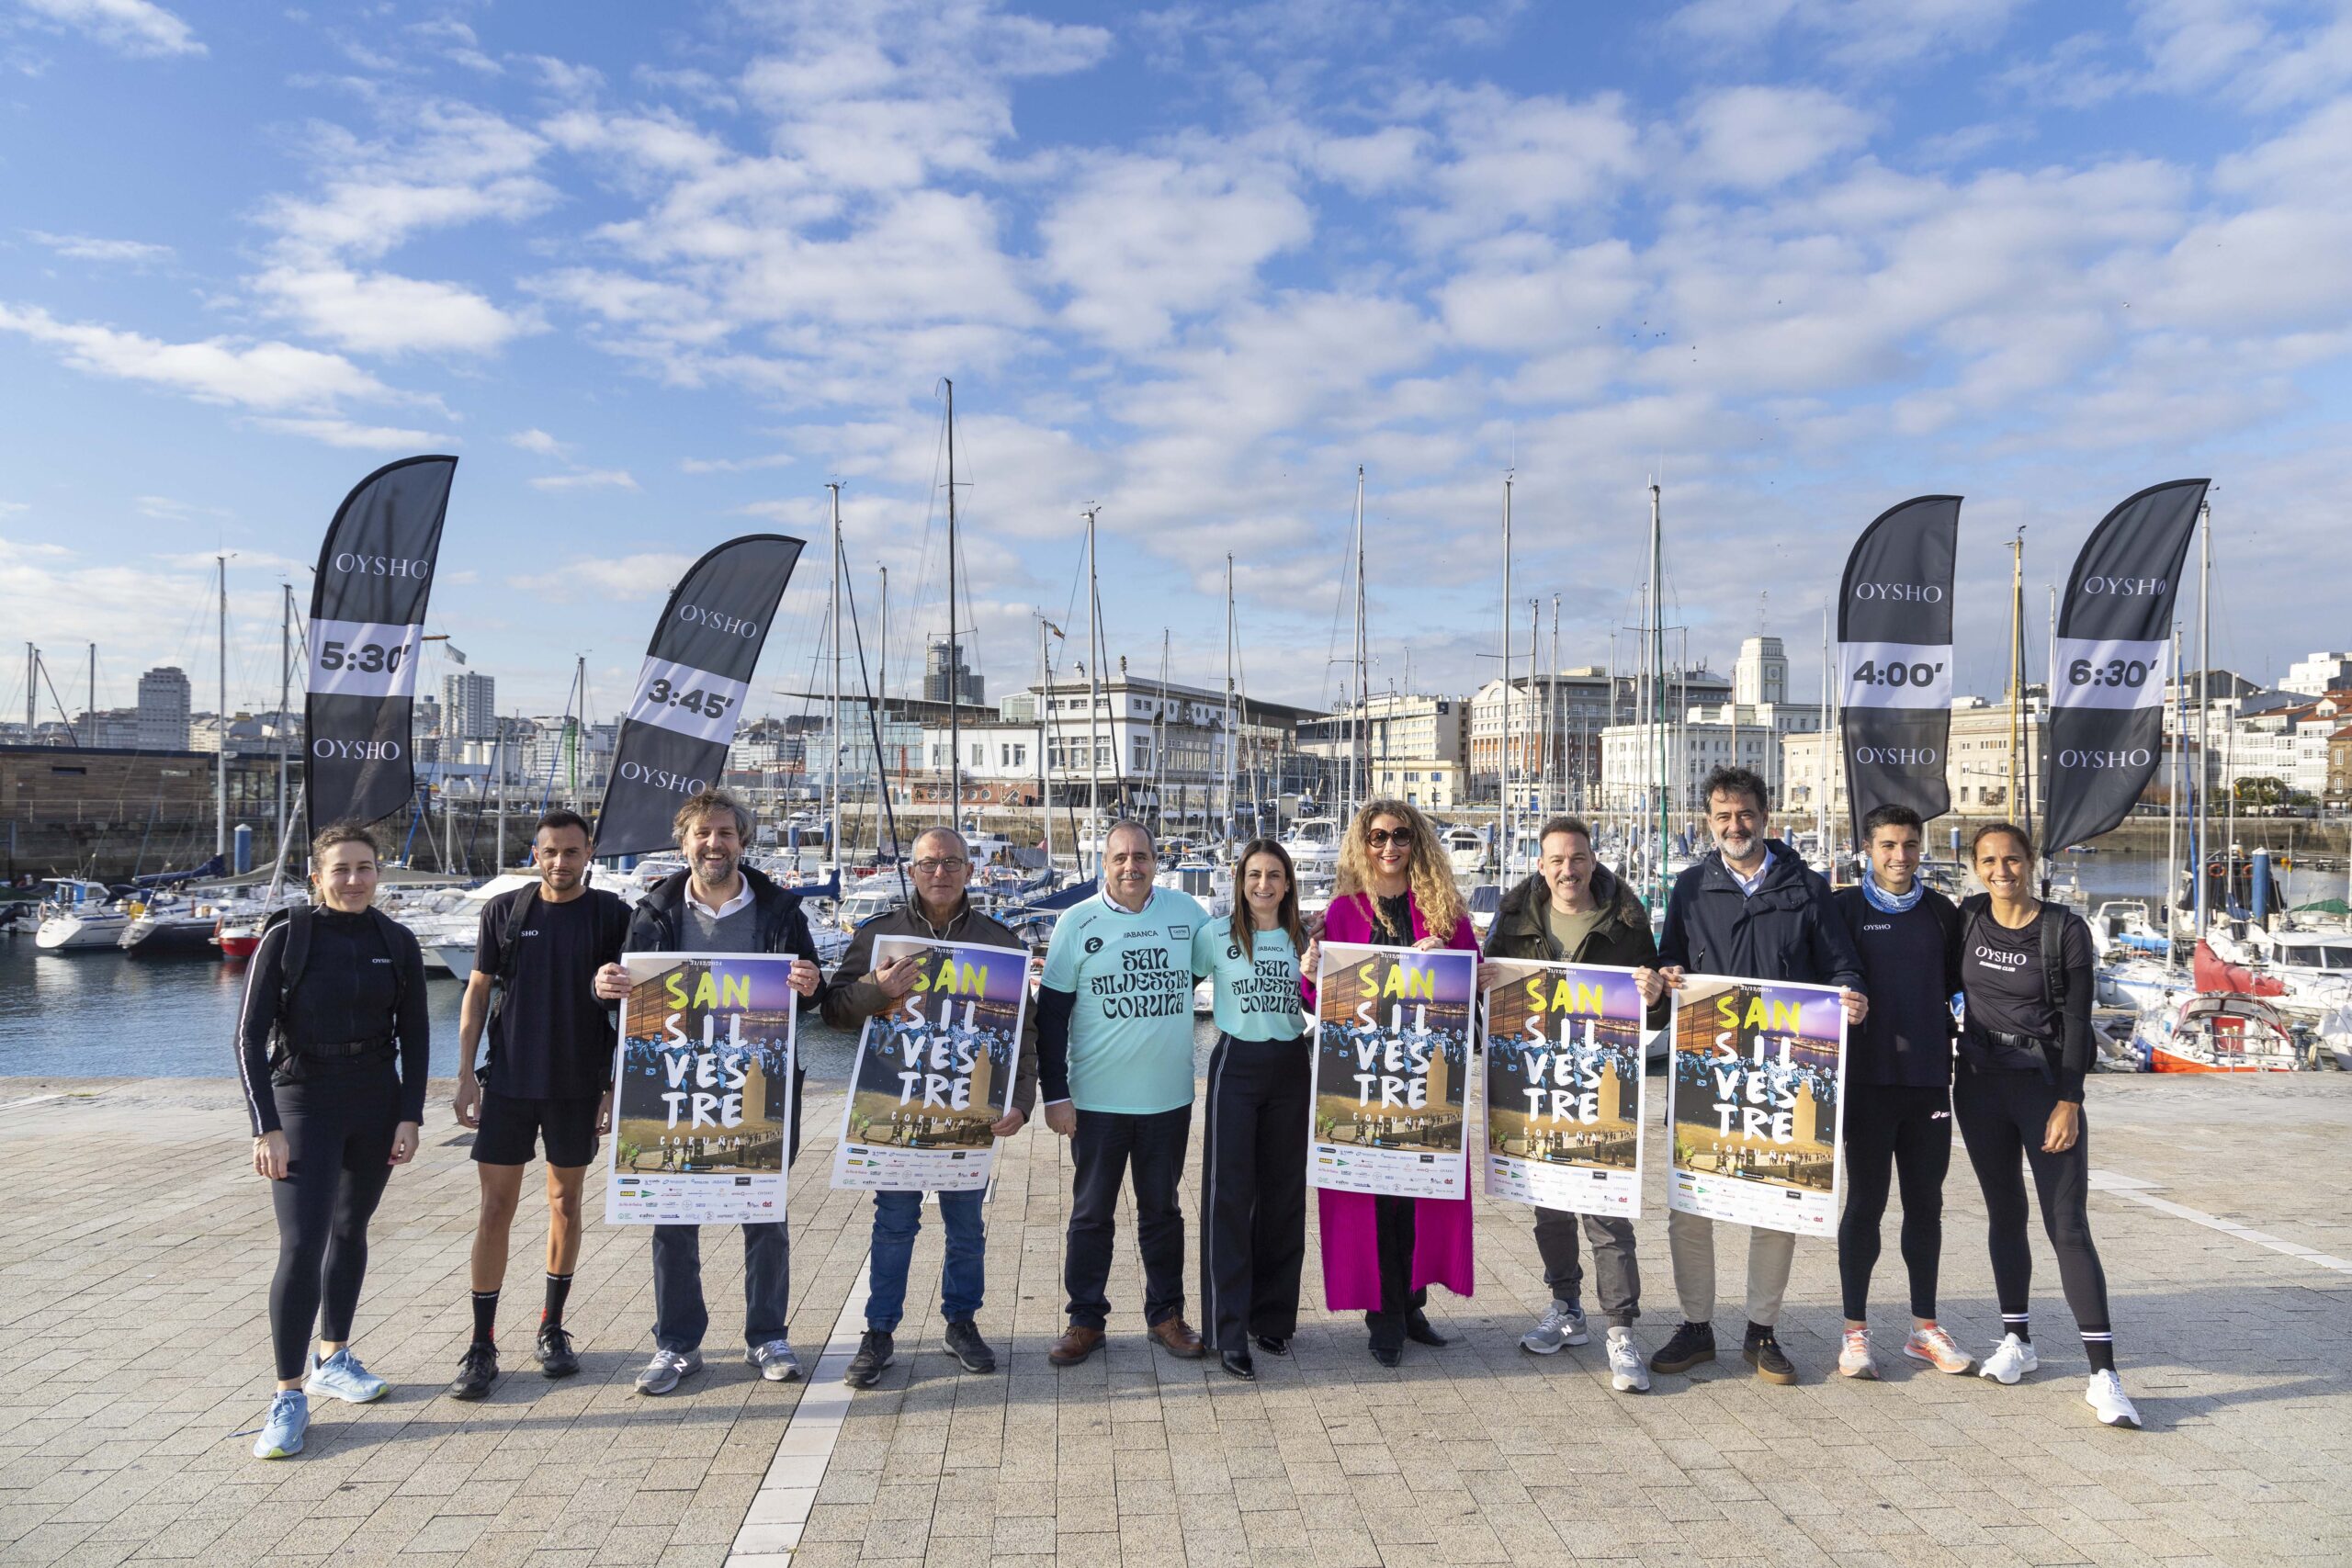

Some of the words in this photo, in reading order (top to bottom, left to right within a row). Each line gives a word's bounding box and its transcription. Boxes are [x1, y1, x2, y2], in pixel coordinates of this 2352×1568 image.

[335, 553, 429, 580] OYSHO
[1856, 582, 1943, 604] OYSHO
[2085, 576, 2166, 596] OYSHO
[680, 604, 757, 638] OYSHO
[313, 739, 401, 761] OYSHO
[1856, 747, 1936, 765] OYSHO
[2059, 749, 2151, 768] OYSHO
[620, 761, 707, 796] OYSHO
[1122, 948, 1169, 972] SAN
[1254, 960, 1290, 978] SAN
[1975, 946, 2027, 965] OYSHO
[666, 972, 750, 1010] SAN
[910, 957, 989, 997] SAN
[1091, 969, 1190, 996] SILVESTRE
[1232, 977, 1302, 998] SILVESTR
[1359, 964, 1435, 1000] SAN
[1102, 990, 1184, 1019] CORUÑA
[1525, 977, 1603, 1016] SAN
[1716, 996, 1802, 1032] SAN
[902, 1032, 976, 1074] VES
[1355, 1038, 1430, 1074] VES
[1524, 1052, 1602, 1089] VES
[664, 1053, 747, 1089] VES
[1714, 1066, 1796, 1110] VES
[898, 1071, 971, 1111] TRE
[1353, 1074, 1428, 1111] TRE
[1522, 1089, 1600, 1125] TRE
[661, 1092, 744, 1130] TRE
[891, 1111, 965, 1127] CORUÑA
[1713, 1103, 1793, 1145] TRE
[660, 1135, 741, 1146] CORUÑA
